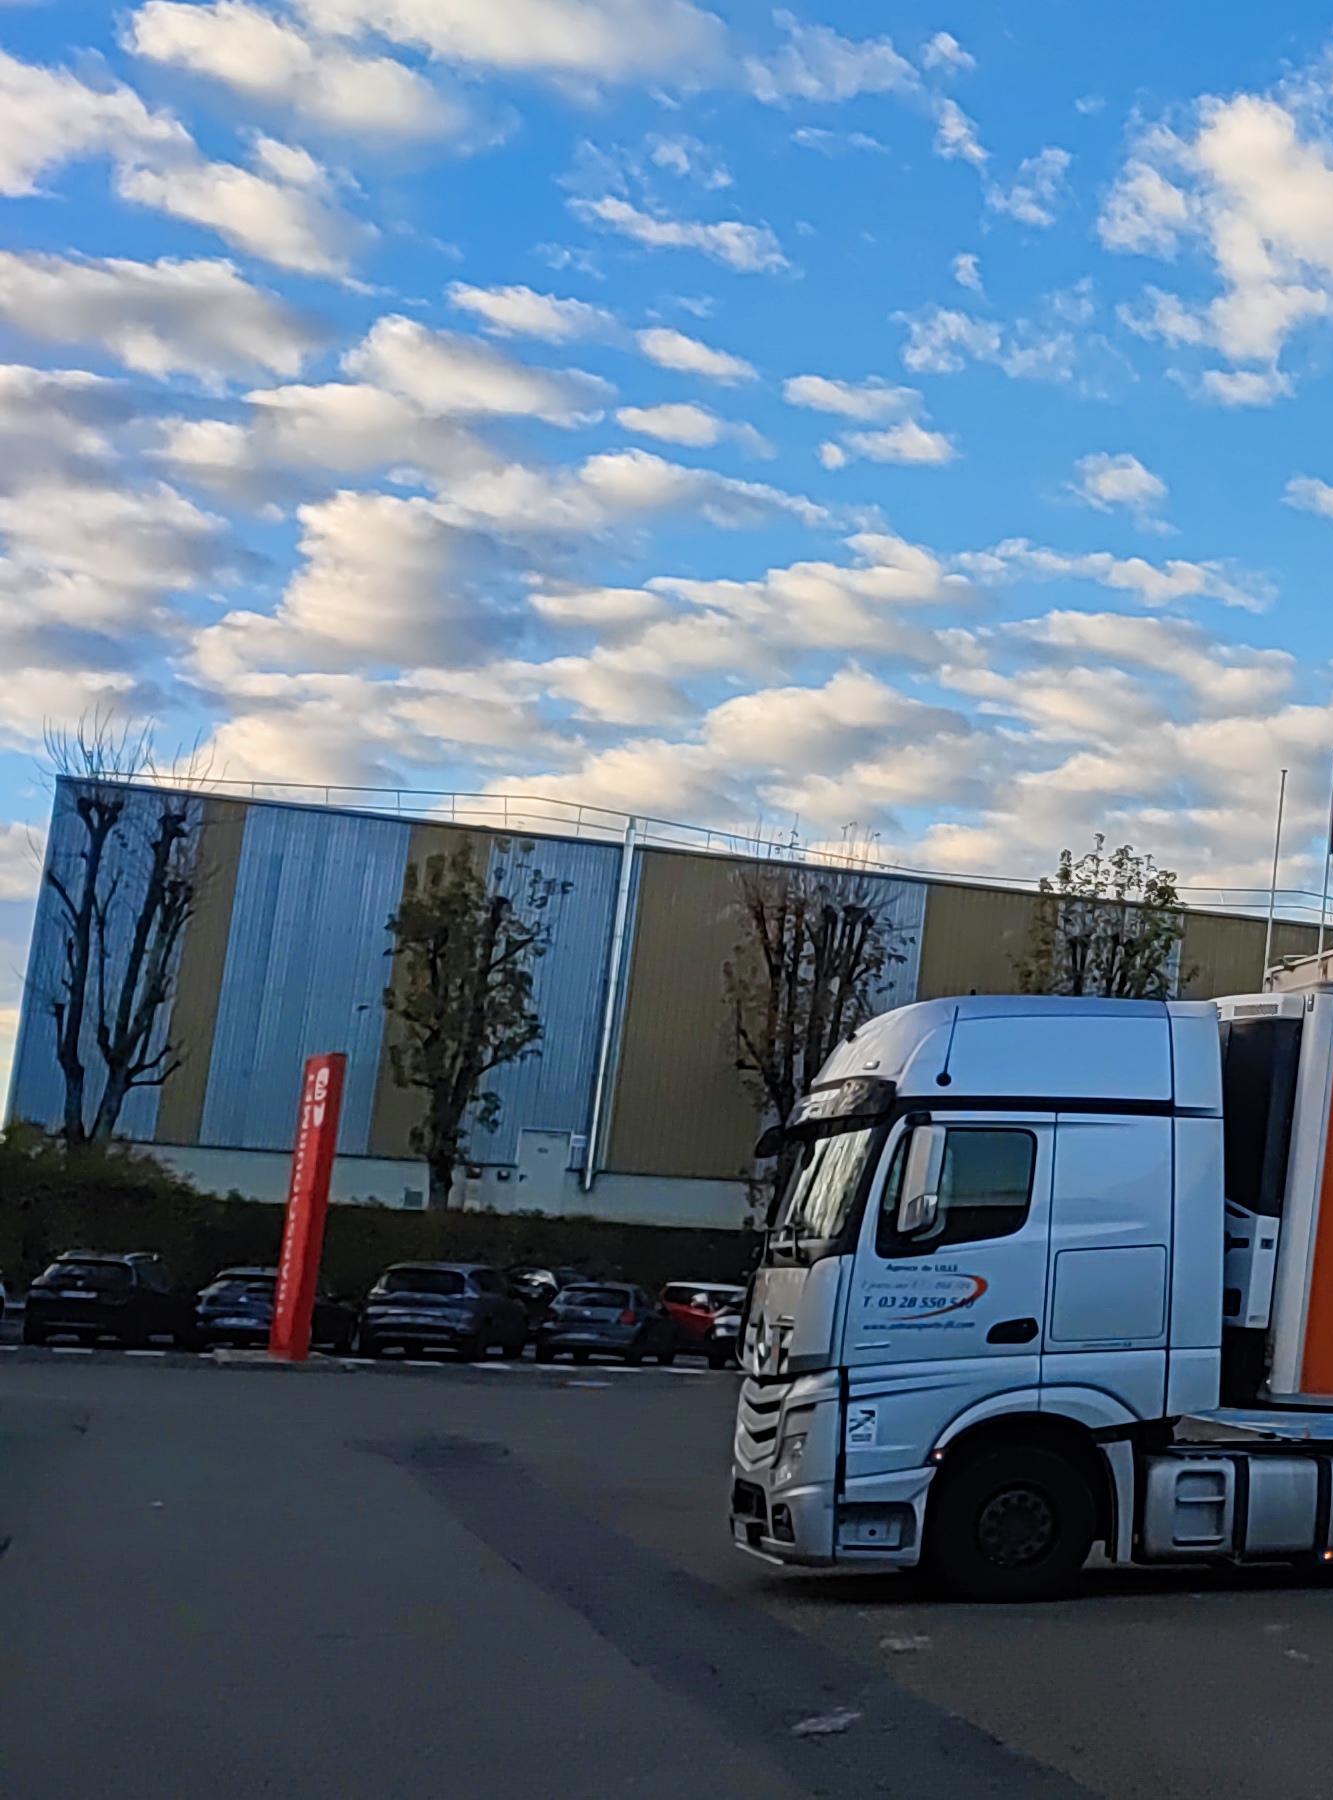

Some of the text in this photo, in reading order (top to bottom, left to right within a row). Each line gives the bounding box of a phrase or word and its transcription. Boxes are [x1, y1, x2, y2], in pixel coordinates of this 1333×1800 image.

[878, 1296, 896, 1308] 03
[898, 1296, 917, 1308] 28
[918, 1296, 946, 1308] 550
